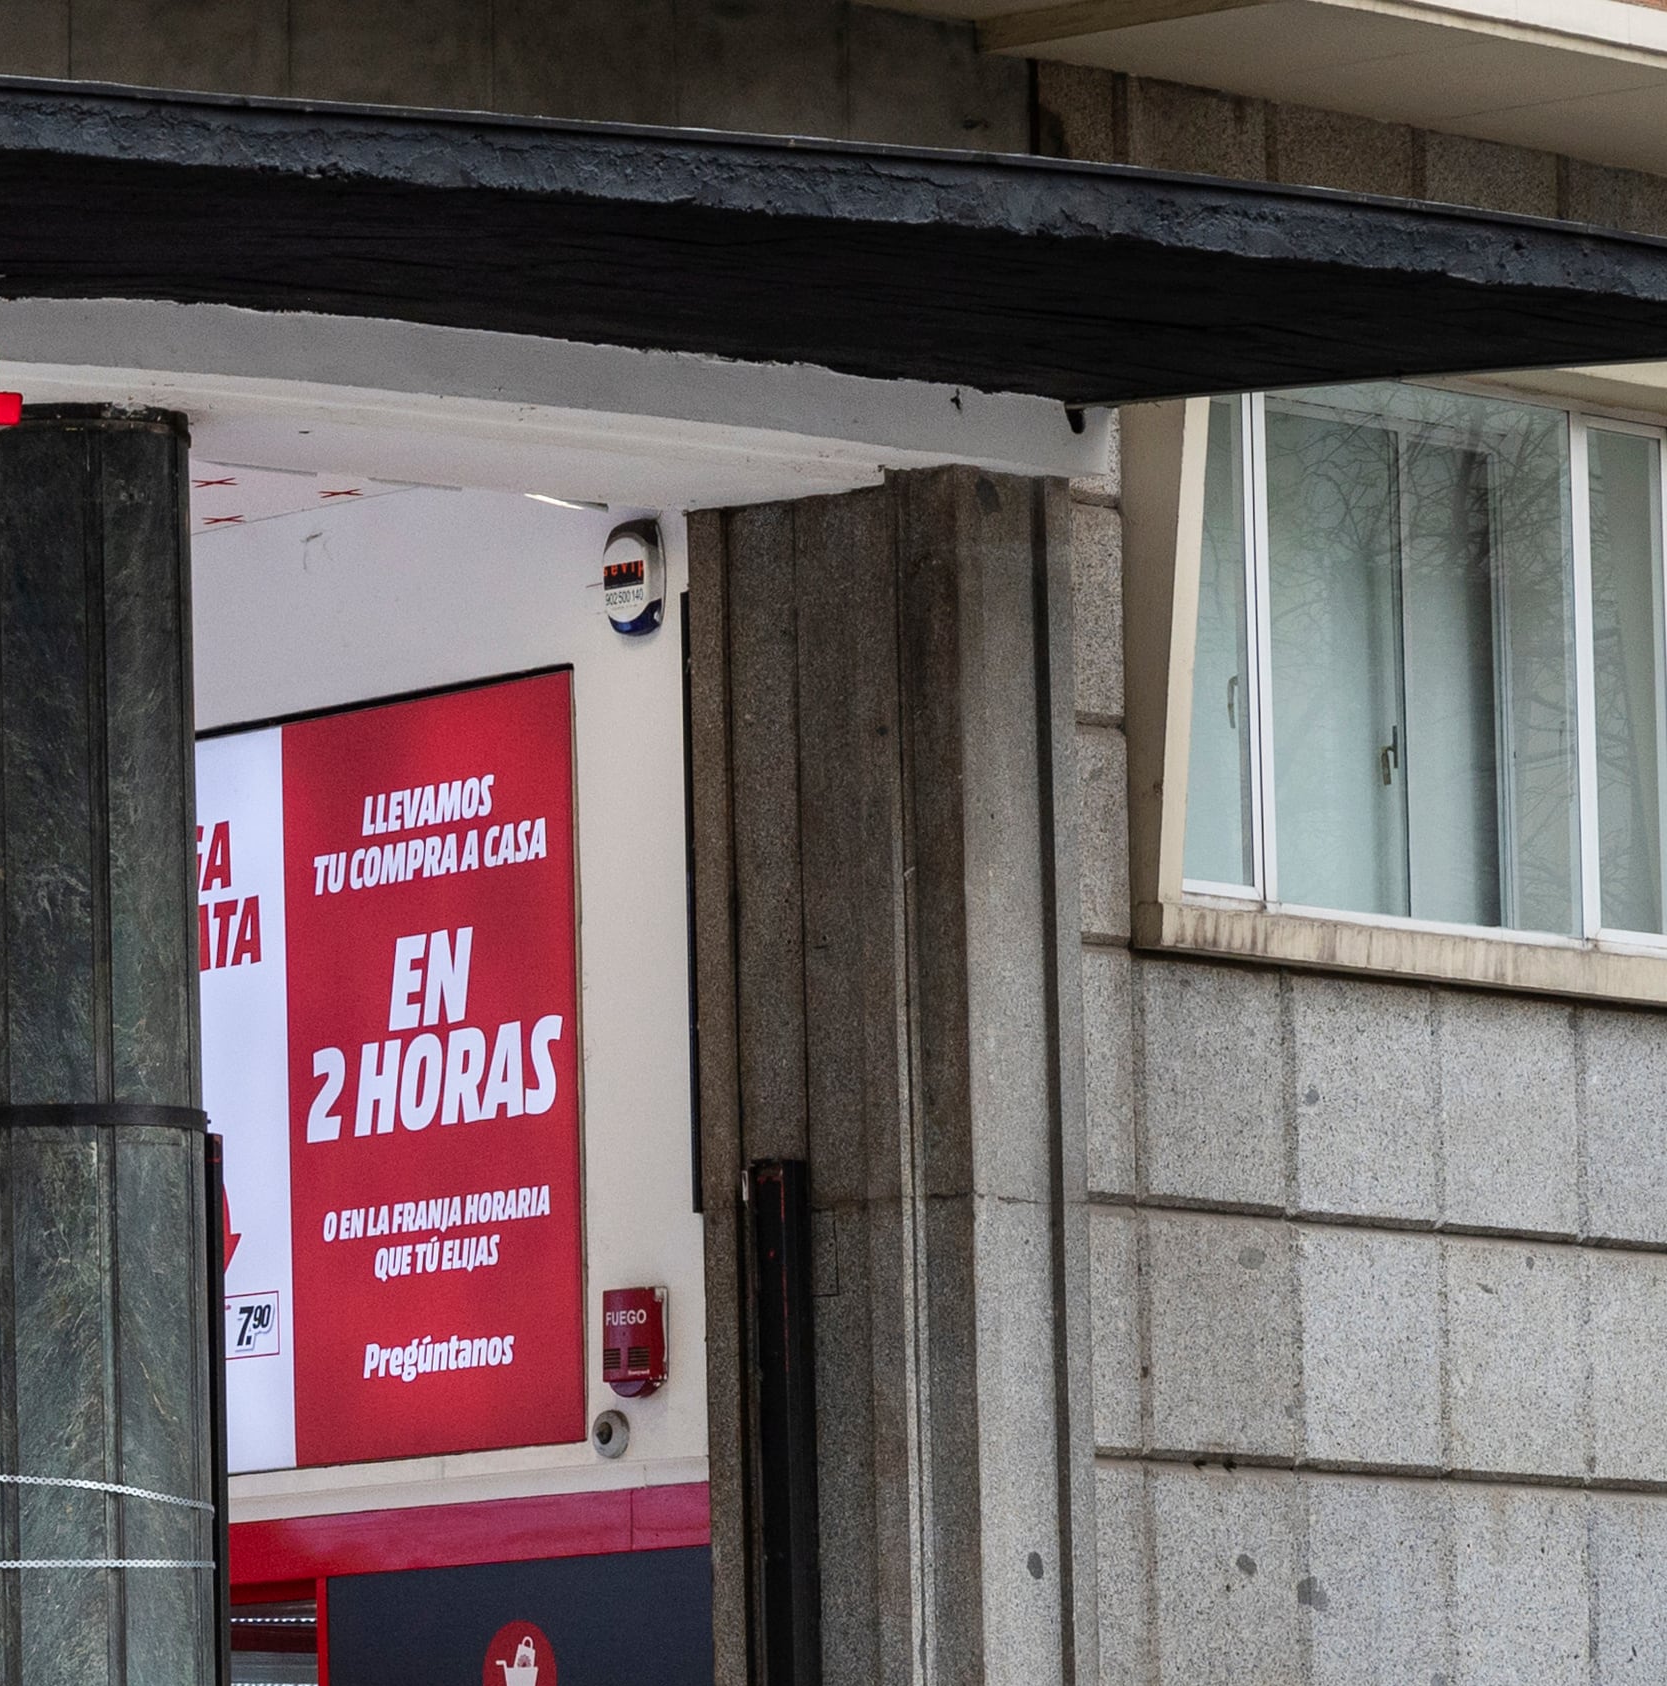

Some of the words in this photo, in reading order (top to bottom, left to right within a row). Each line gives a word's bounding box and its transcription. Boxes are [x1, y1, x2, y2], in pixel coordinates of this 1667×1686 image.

[361, 774, 495, 837] LLEVAMOS
[313, 852, 347, 896] TU
[349, 833, 457, 890] COMPRA
[460, 829, 479, 872] A
[483, 817, 547, 868] CASA
[388, 926, 473, 1031] EN
[307, 1047, 346, 1146] 2
[355, 1015, 563, 1138] HORAS
[323, 1211, 338, 1242] O
[339, 1208, 365, 1240] EN
[366, 1205, 390, 1237] LA
[392, 1196, 461, 1233] FRANJA
[464, 1184, 551, 1225] HORARIA
[374, 1245, 413, 1282] QUE
[415, 1236, 440, 1273] TÚ
[441, 1234, 501, 1272] ELIJAS
[605, 1309, 647, 1326] FUEGO
[363, 1335, 514, 1380] Pregúntanos
